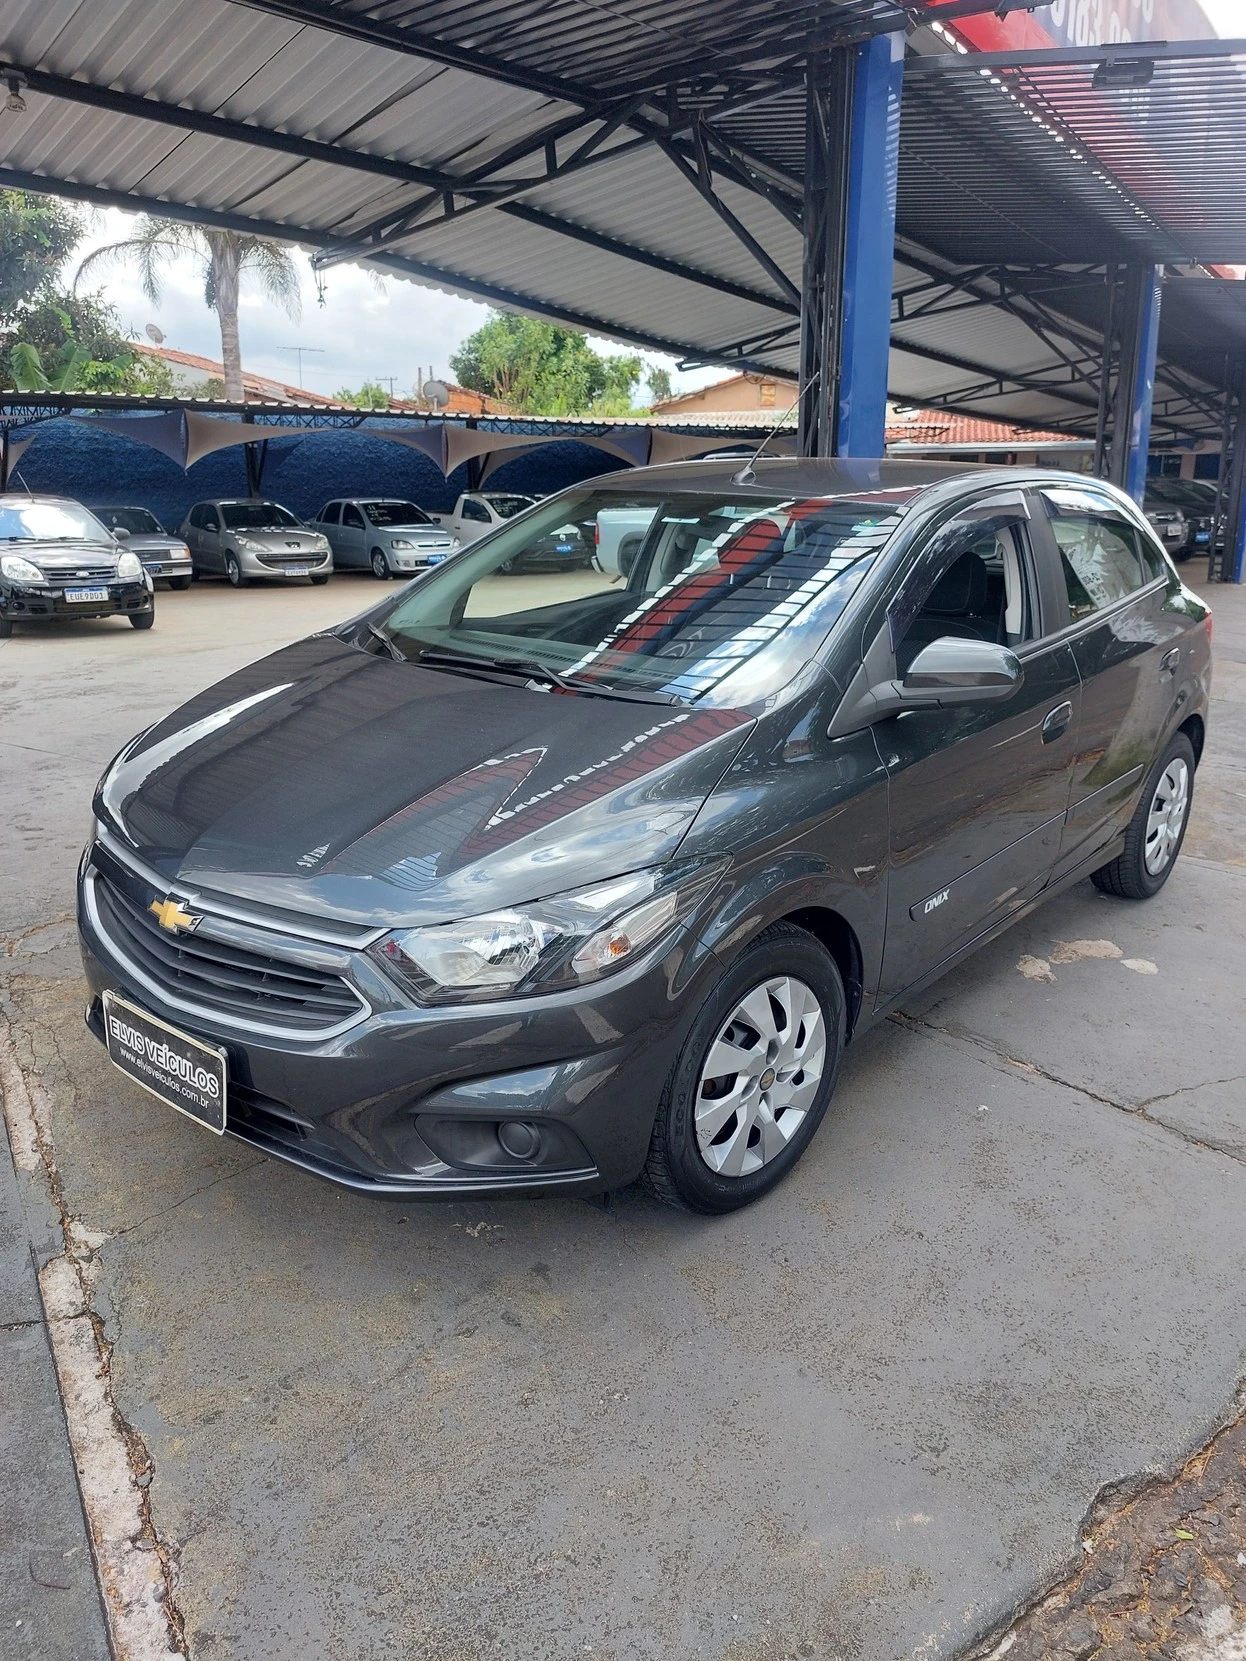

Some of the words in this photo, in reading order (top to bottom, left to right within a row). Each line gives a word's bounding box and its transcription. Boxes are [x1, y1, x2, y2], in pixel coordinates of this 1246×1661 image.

[924, 888, 950, 914] ONIX
[109, 1015, 146, 1056] ELVIS
[119, 1046, 210, 1109] www.elvisveiculos.com.br
